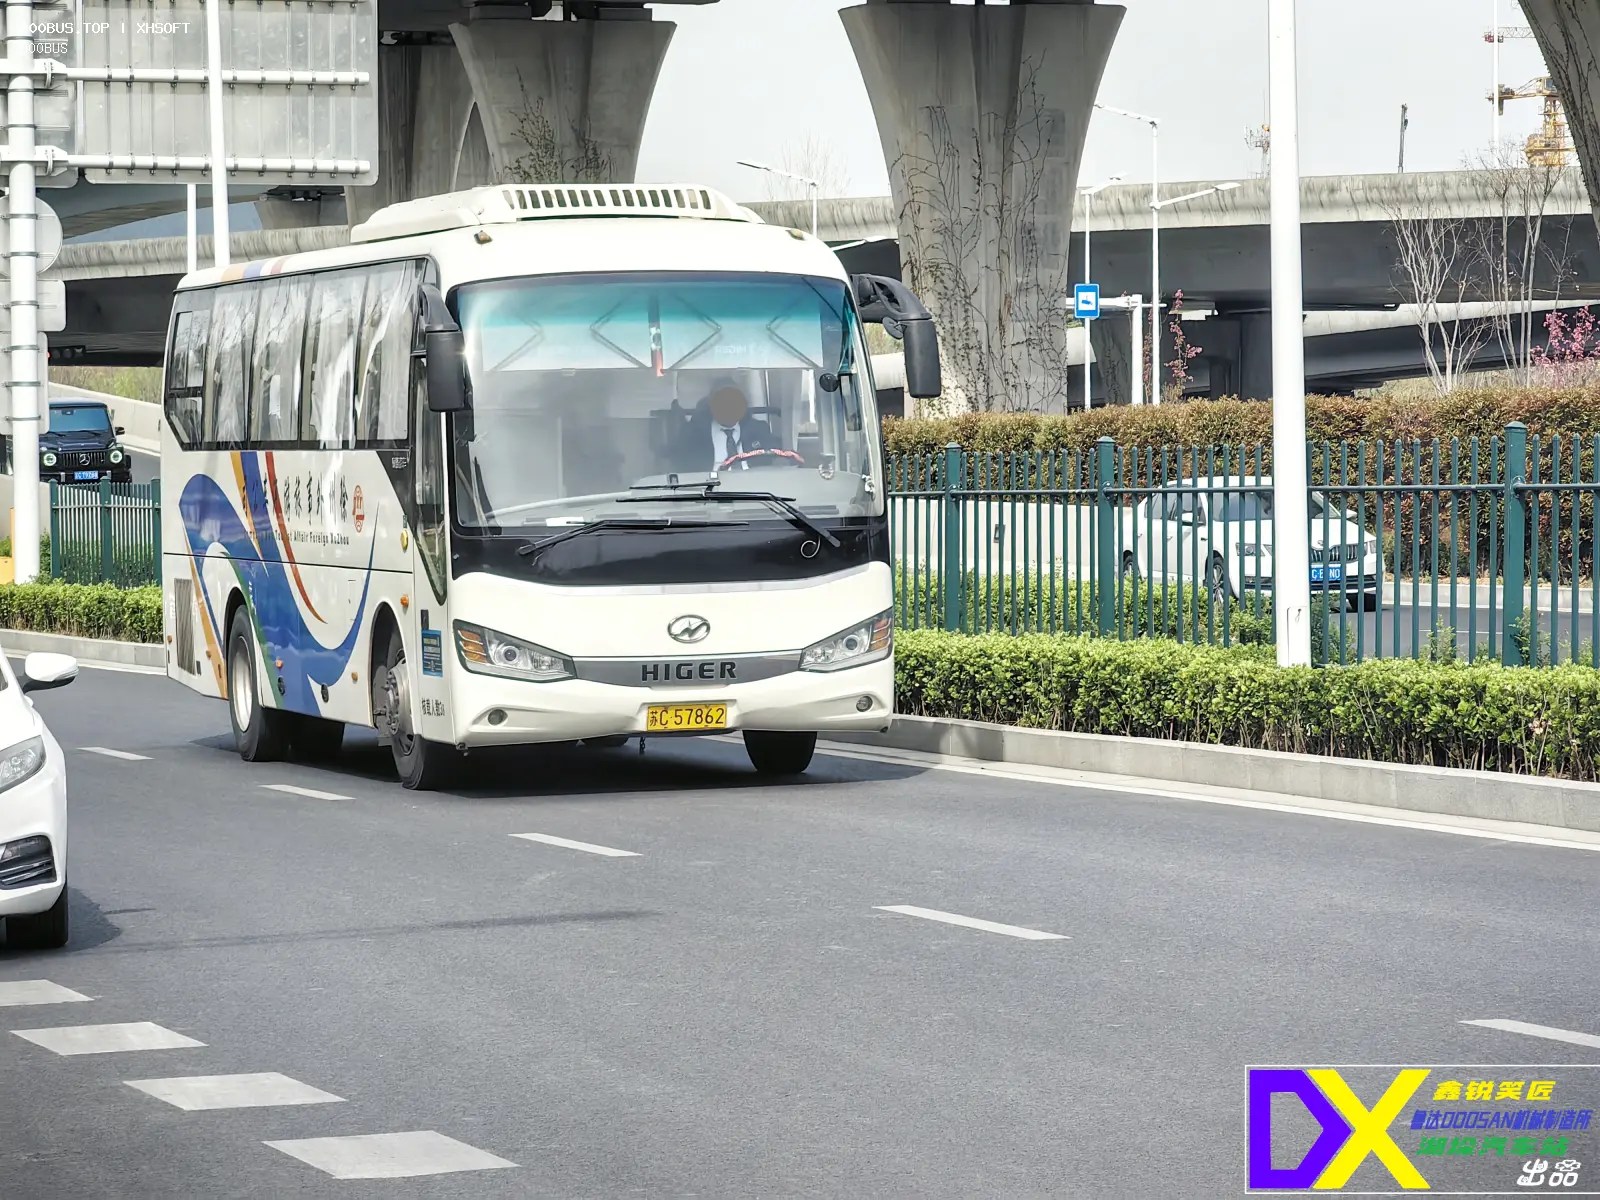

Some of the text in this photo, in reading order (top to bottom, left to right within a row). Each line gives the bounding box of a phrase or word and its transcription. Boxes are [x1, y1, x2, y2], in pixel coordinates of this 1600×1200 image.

[309, 531, 329, 547] Foreign
[641, 661, 736, 681] HIGER
[649, 707, 725, 727] 苏C·57862
